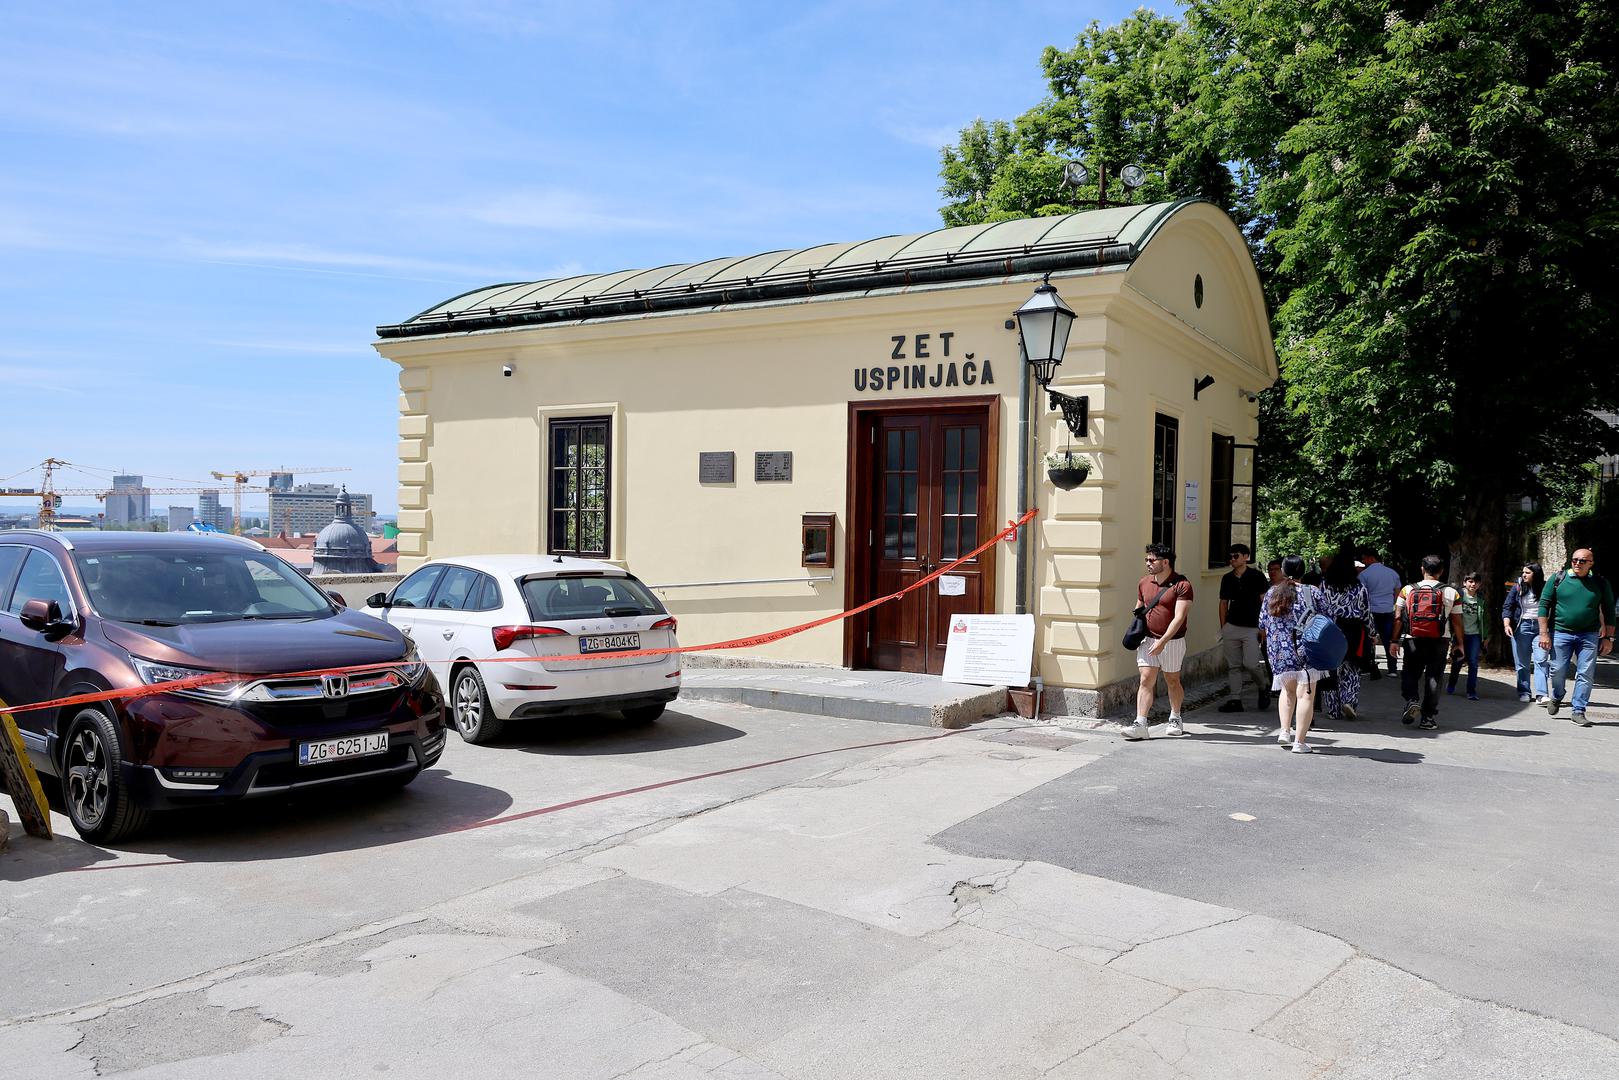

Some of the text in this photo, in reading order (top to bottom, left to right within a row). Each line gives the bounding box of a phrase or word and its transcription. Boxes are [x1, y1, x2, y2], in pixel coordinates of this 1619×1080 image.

[891, 332, 955, 360] ZET
[854, 352, 995, 392] USPINJAČA
[588, 638, 600, 650] ZG
[310, 744, 327, 760] ZG
